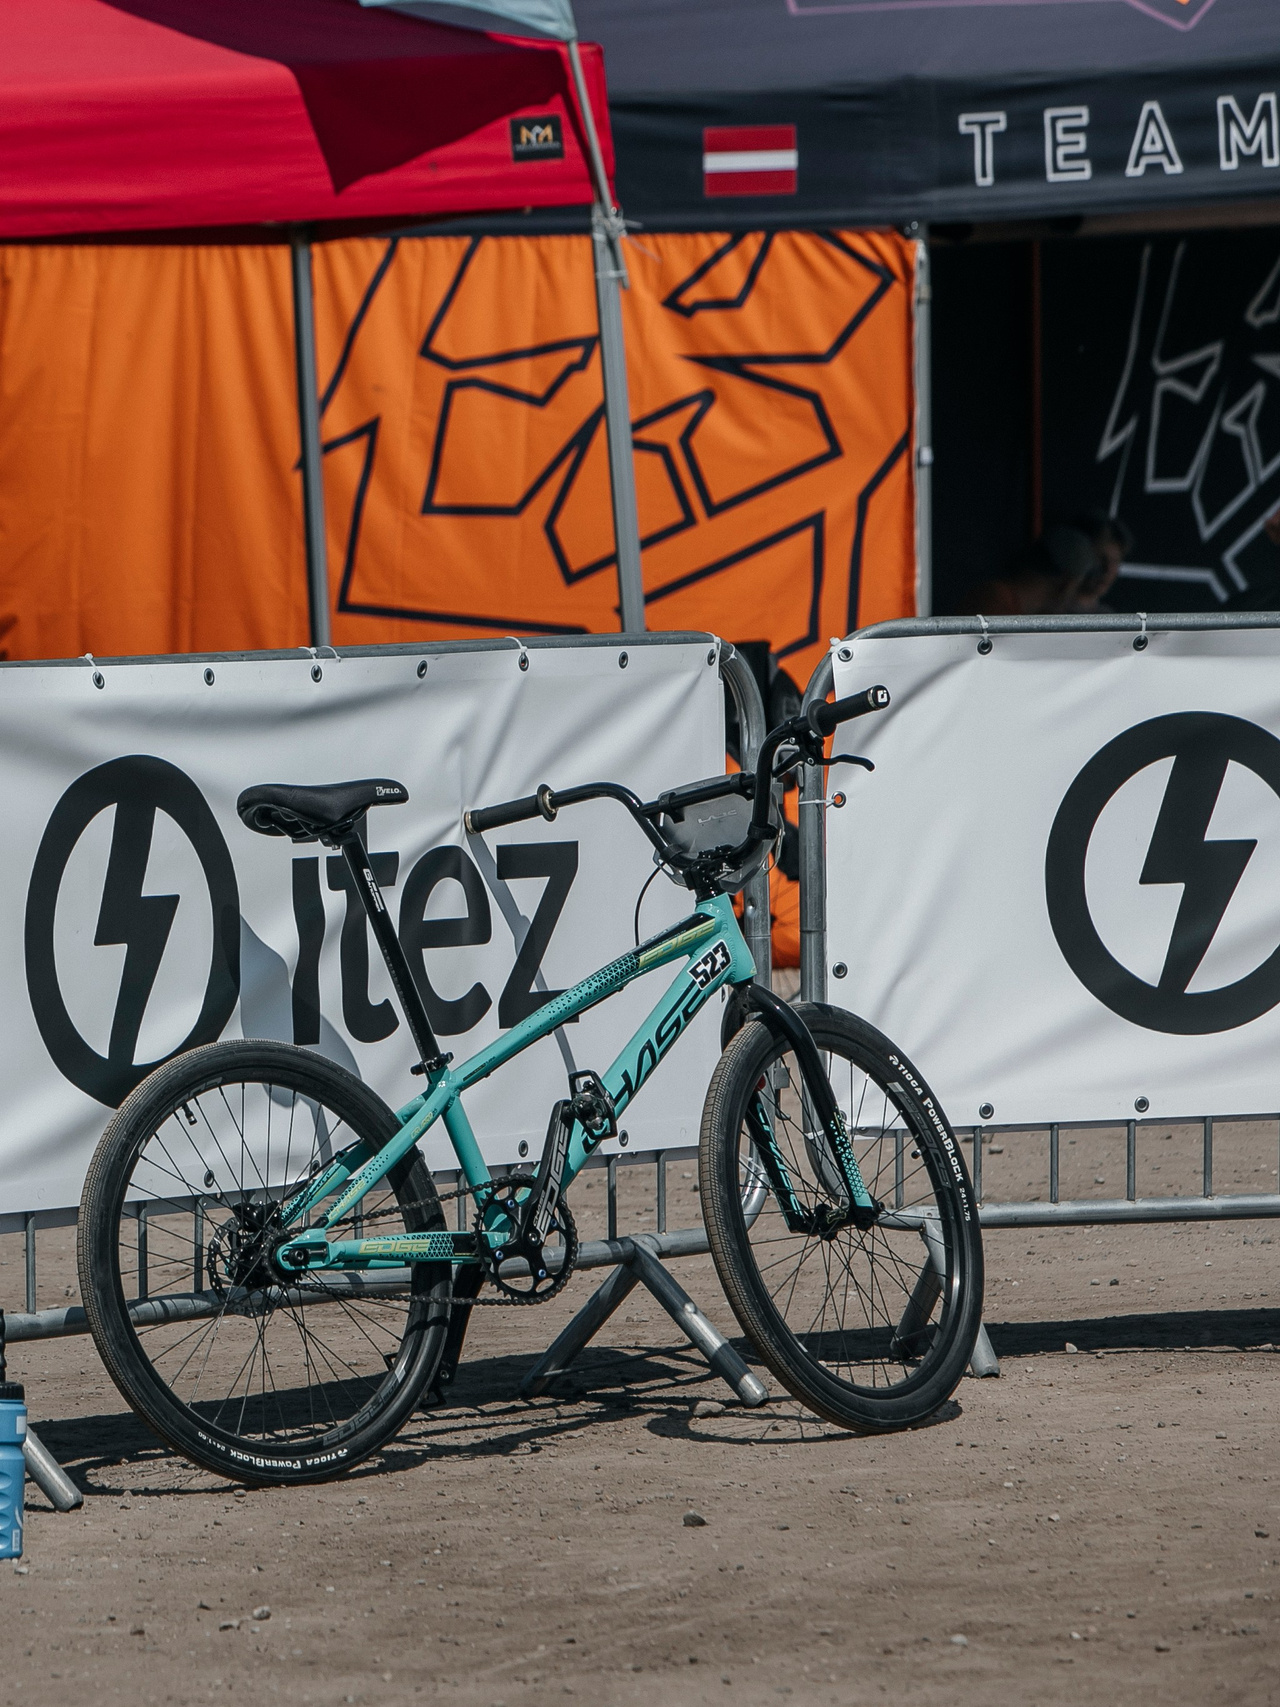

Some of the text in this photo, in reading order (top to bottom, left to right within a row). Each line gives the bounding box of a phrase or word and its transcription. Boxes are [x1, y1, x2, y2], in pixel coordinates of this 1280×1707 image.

[958, 92, 1280, 187] TEAM
[690, 942, 731, 989] 523
[897, 1063, 924, 1097] TIOGA
[306, 1452, 337, 1466] TIOGA
